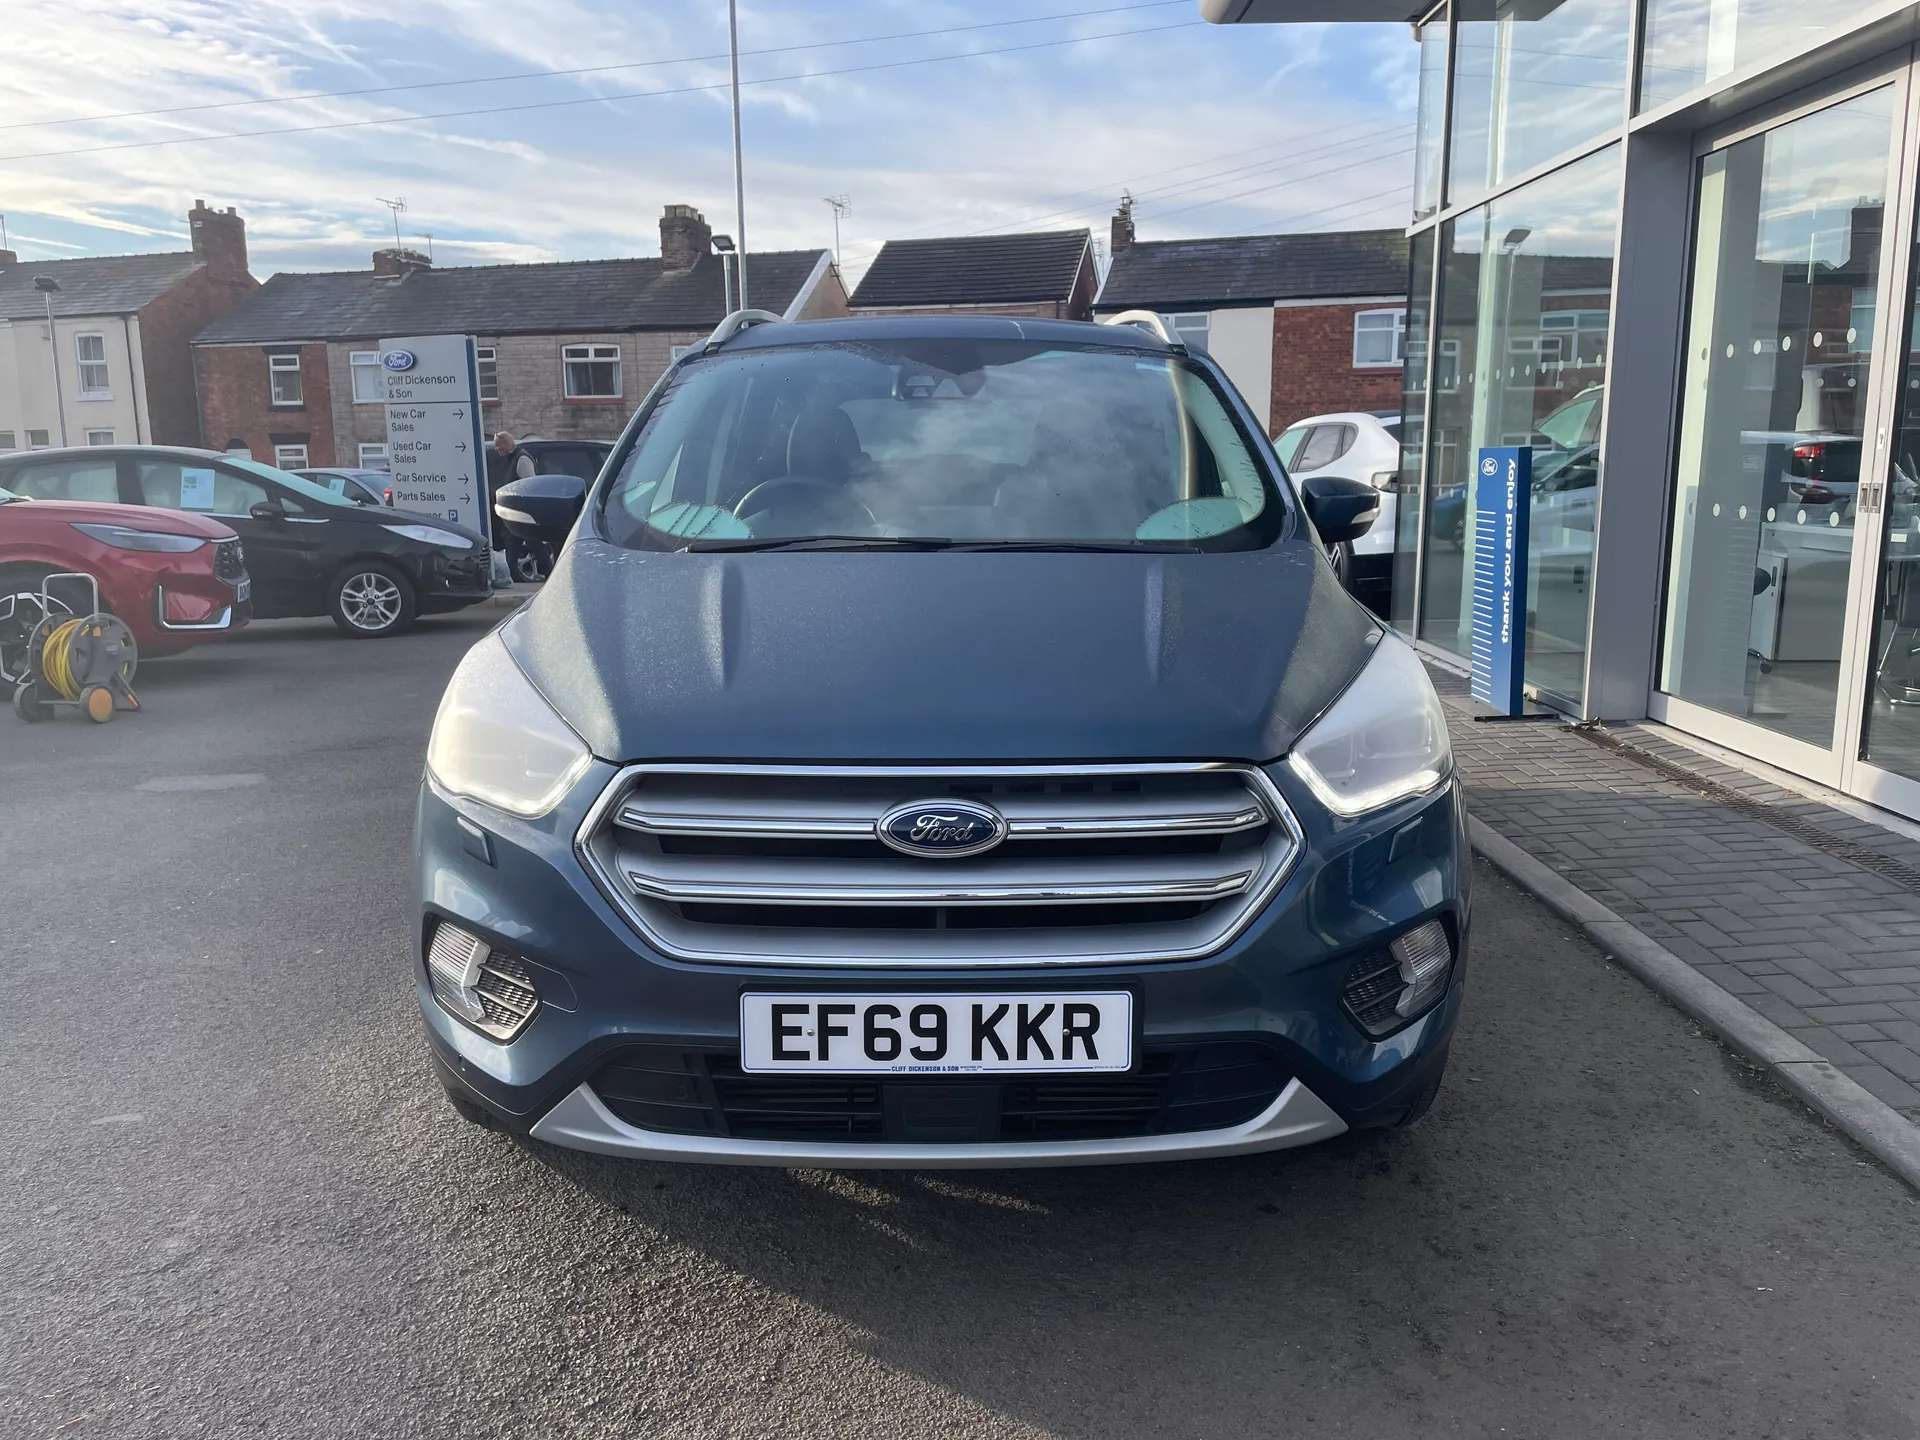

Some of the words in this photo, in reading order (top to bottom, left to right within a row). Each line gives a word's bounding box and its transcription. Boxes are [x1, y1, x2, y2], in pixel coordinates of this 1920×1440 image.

[387, 375, 404, 386] Cliff
[405, 374, 456, 385] Dickenson
[388, 389, 395, 398] &
[396, 388, 413, 398] Son
[390, 410, 408, 420] New
[410, 409, 426, 419] Car
[391, 422, 415, 432] Sales
[393, 441, 414, 451] Used
[415, 441, 432, 451] Car
[394, 453, 417, 463] Sales
[396, 473, 410, 482] Car
[411, 472, 447, 482] Service
[1507, 458, 1516, 510] enjoy
[397, 491, 418, 501] Parts
[420, 491, 446, 501] Sales
[1505, 513, 1513, 550] and
[1504, 553, 1512, 587] you
[1502, 590, 1510, 644] thank
[910, 814, 974, 841] Ford
[771, 1003, 948, 1061] EF69
[971, 1003, 1101, 1061] KKR
